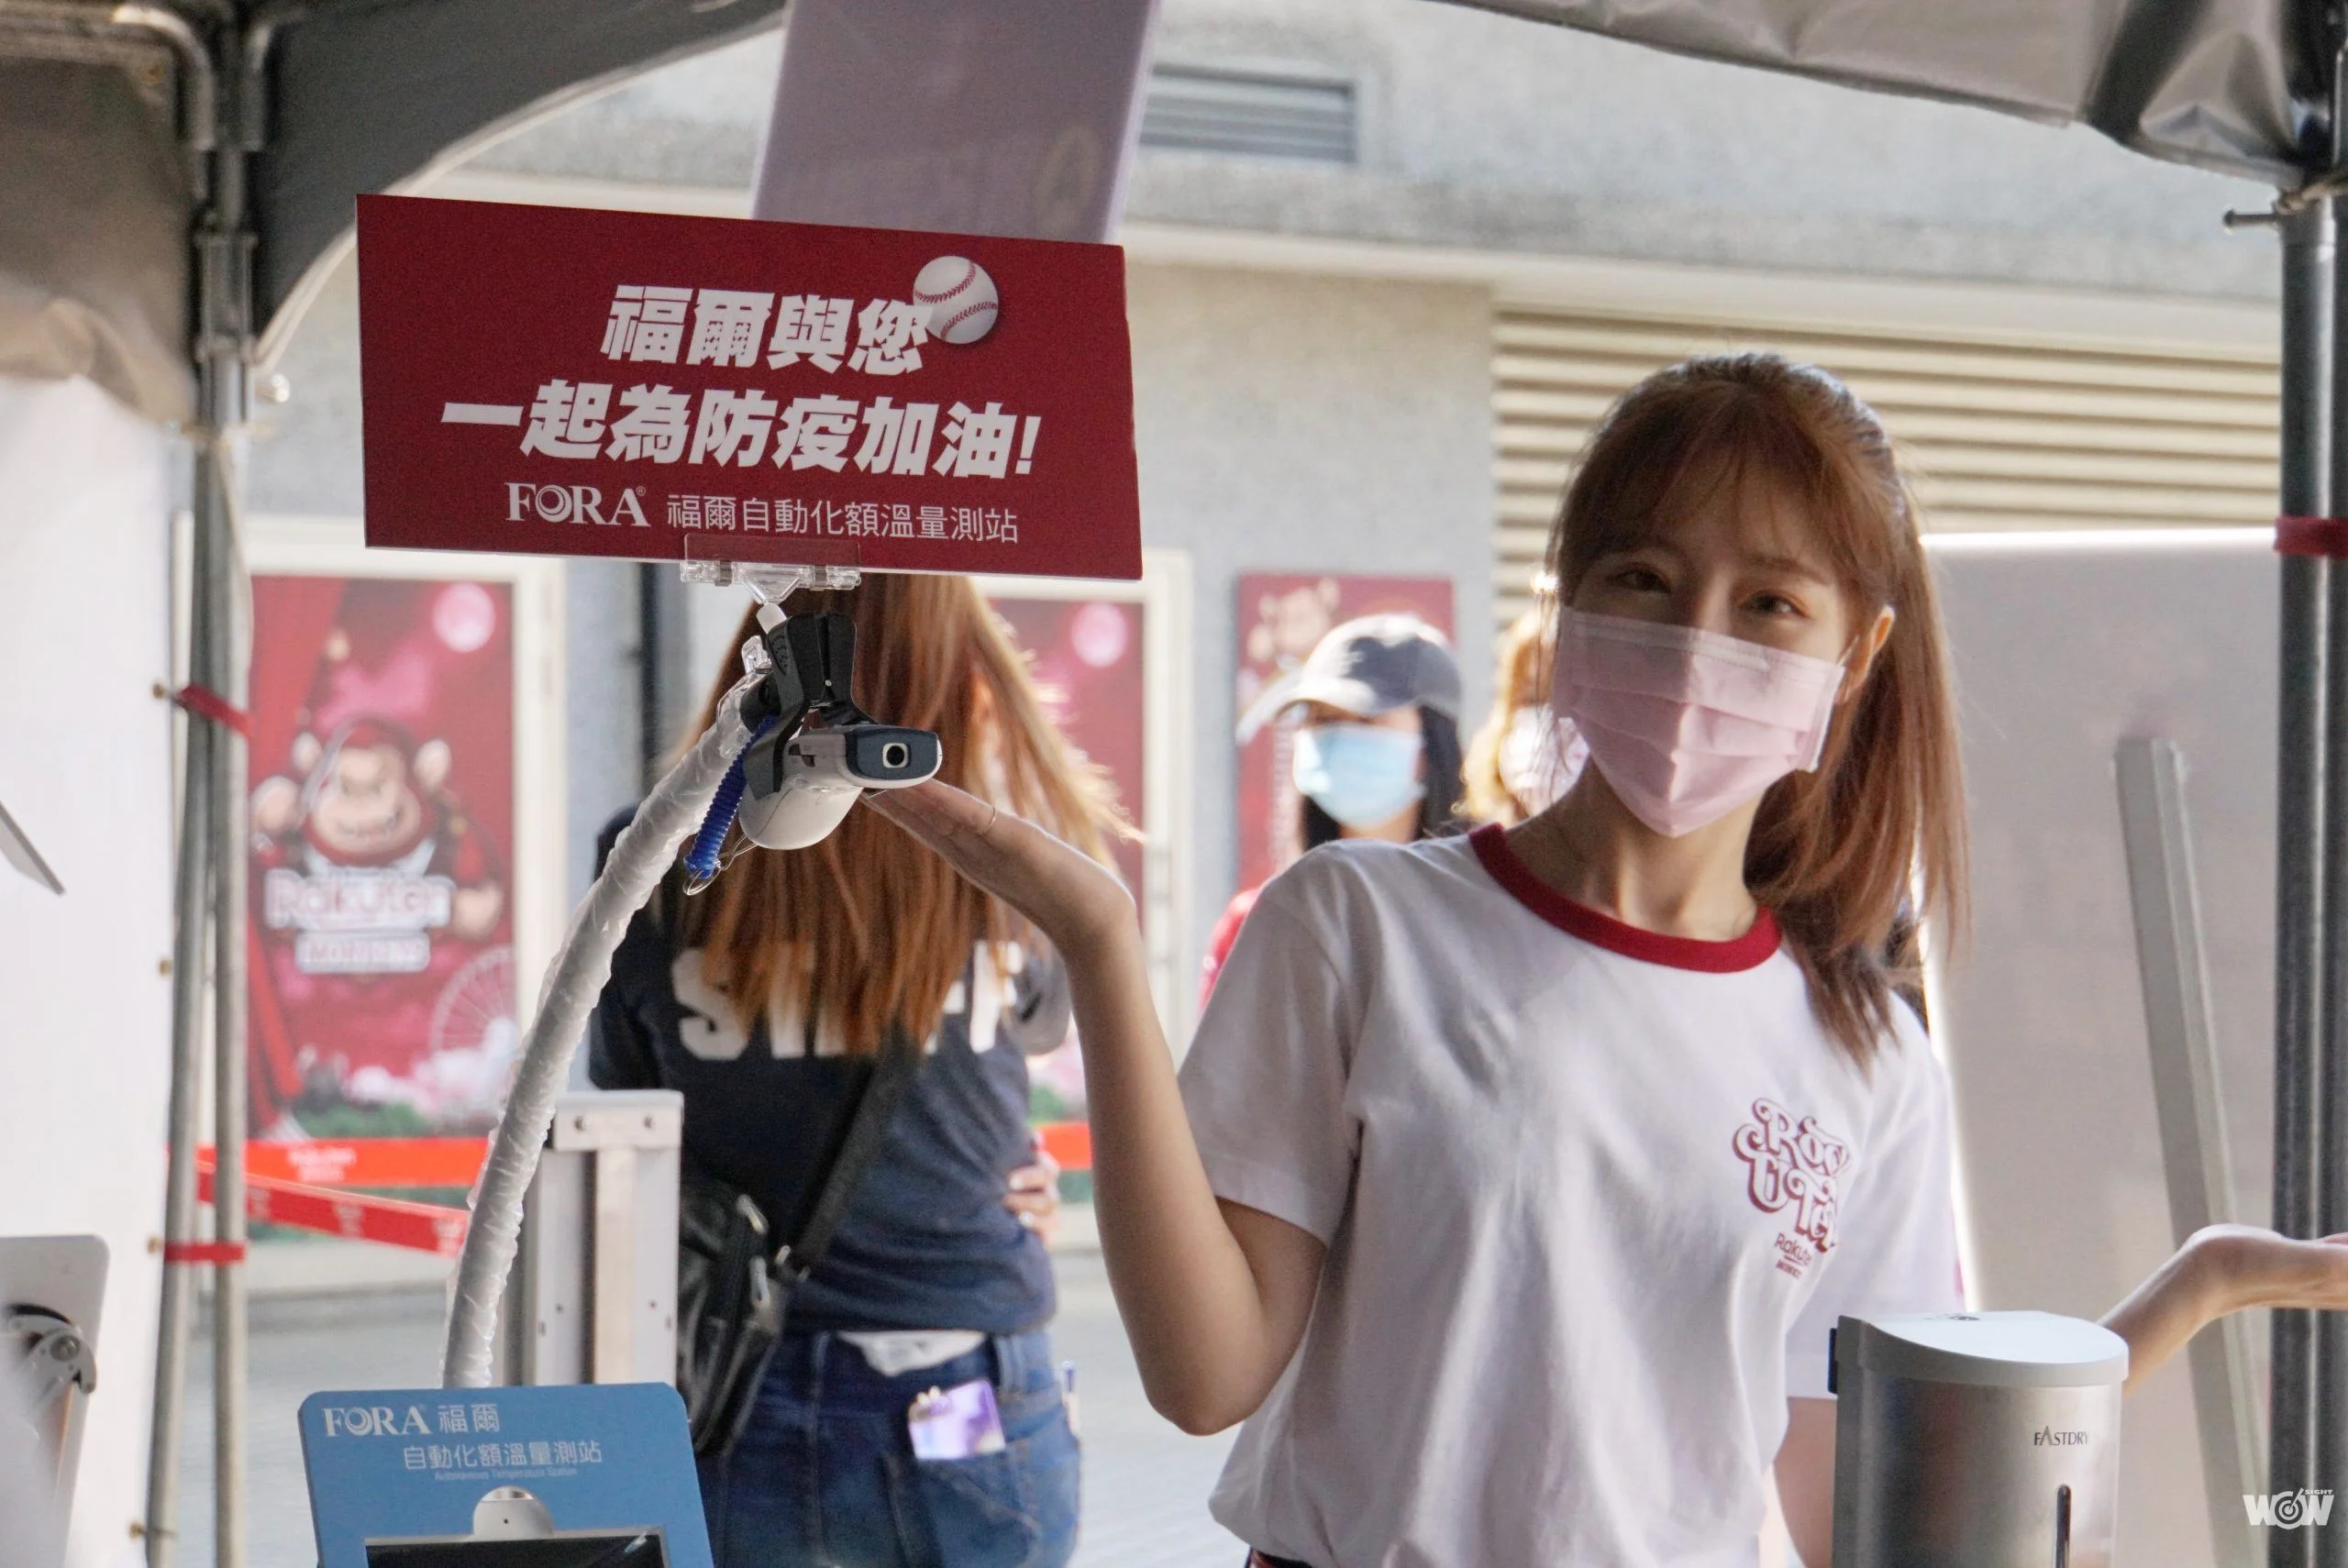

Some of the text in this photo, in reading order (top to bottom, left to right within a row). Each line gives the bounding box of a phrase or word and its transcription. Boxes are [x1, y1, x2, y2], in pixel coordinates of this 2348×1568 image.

[601, 283, 934, 378] 福爾與您
[441, 378, 1042, 480] 一起為防疫加油!
[667, 492, 1019, 545] 福爾自動化額溫量測站
[323, 1403, 501, 1438] FORA 福爾
[2033, 1425, 2089, 1446] FASTDRY
[404, 1441, 603, 1471] 自動化額溫量測站
